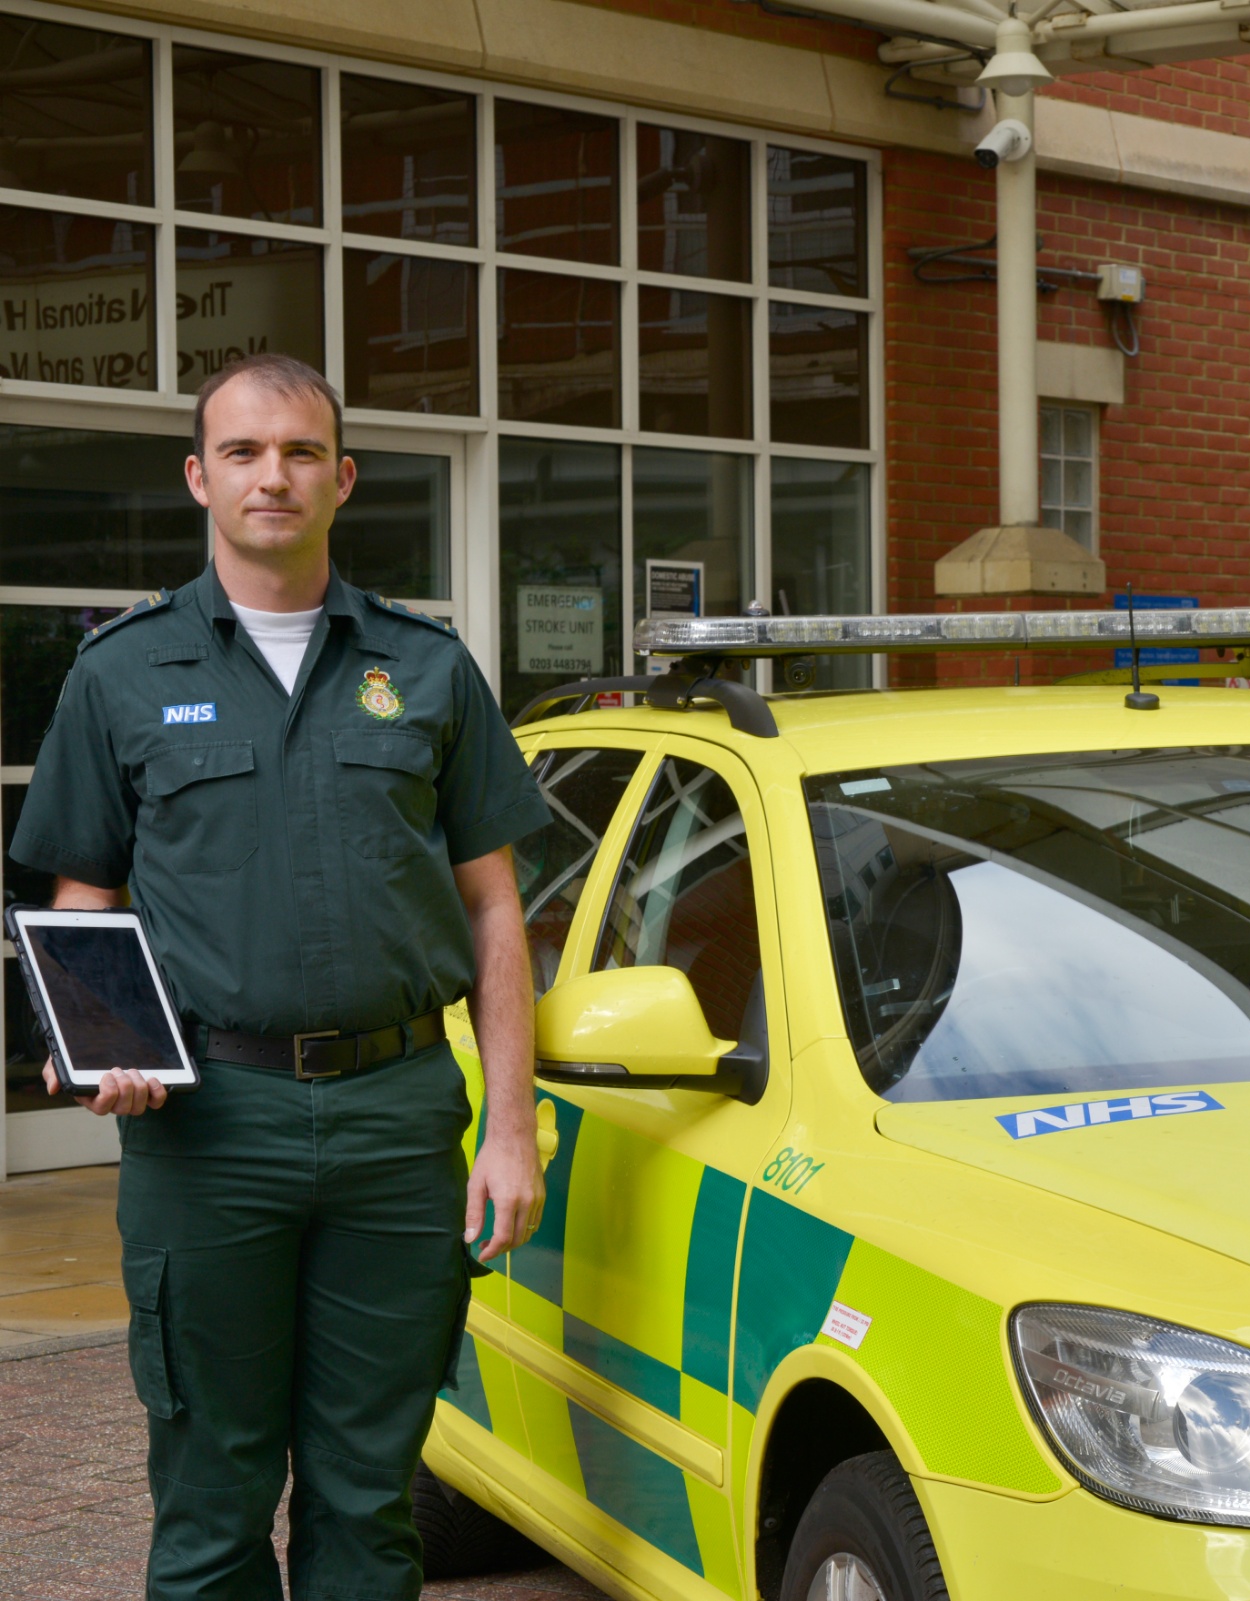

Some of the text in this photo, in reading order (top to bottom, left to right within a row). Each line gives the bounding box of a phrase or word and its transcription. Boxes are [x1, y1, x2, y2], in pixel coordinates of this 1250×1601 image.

[527, 593, 594, 609] EMERGENCY
[525, 619, 594, 635] STROKE UNIT
[529, 657, 552, 670] 0203
[166, 704, 213, 723] NHS
[1015, 1091, 1208, 1138] NHS
[762, 1146, 826, 1196] 8101
[1053, 1368, 1127, 1405] Octavia
